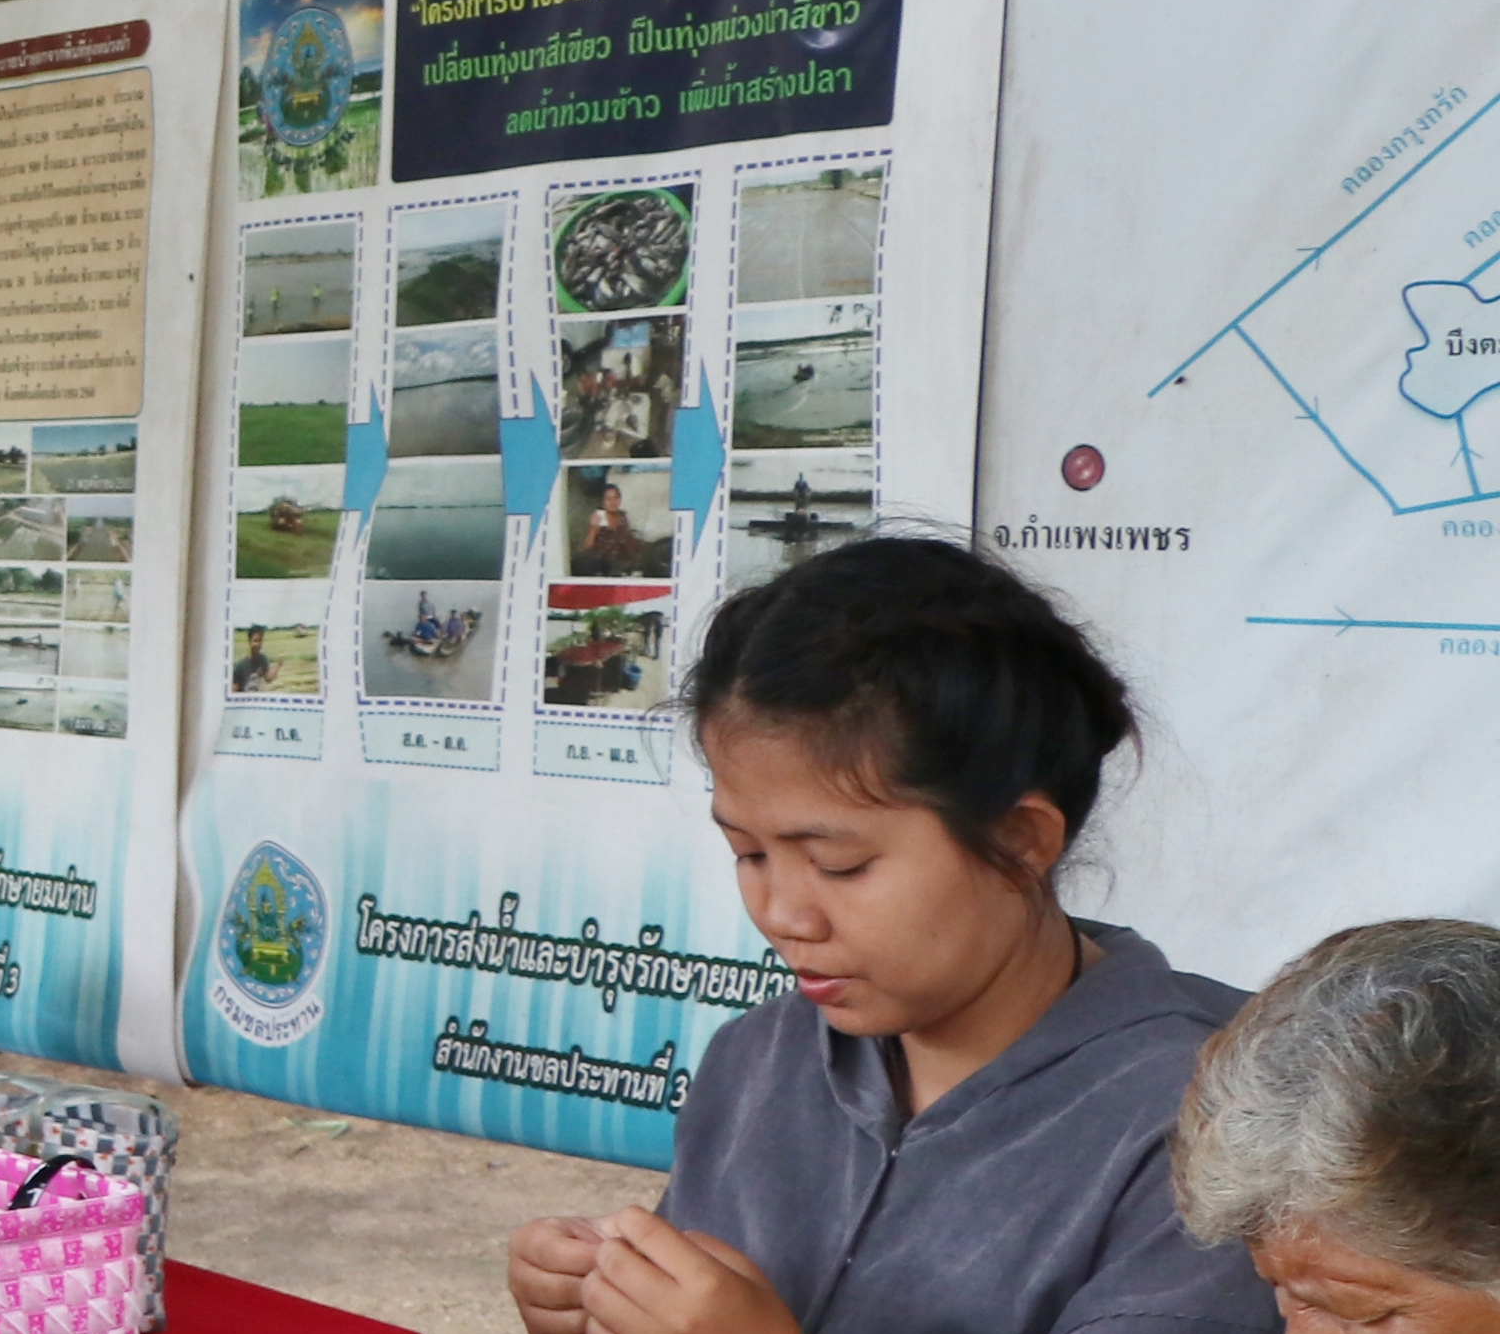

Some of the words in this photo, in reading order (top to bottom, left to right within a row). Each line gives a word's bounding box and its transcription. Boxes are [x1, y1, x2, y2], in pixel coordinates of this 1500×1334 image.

[423, 19, 612, 84] เปลี่ยนทุ่งนาสีเขียว
[505, 88, 662, 137] ลดน้ำท่วมข้าว
[679, 59, 853, 116] เพิ่มน้ำสร้างปลา
[1339, 82, 1469, 196] คลองกรุงกรัก
[994, 516, 1191, 553] จ.กำแพงเพชร
[435, 1017, 667, 1105] สำนักงานชลประทานที่
[668, 1070, 690, 1108] 3
